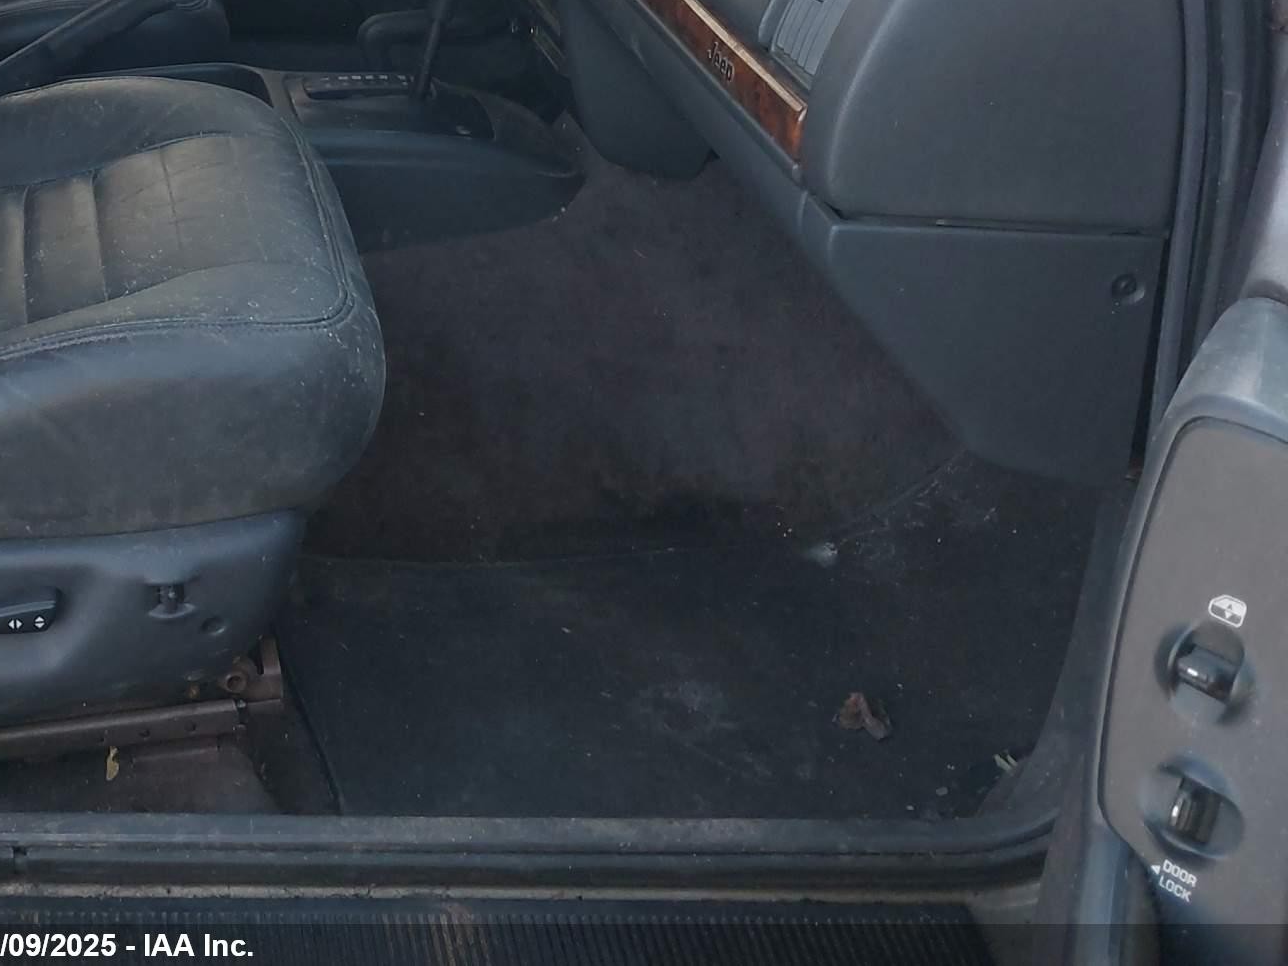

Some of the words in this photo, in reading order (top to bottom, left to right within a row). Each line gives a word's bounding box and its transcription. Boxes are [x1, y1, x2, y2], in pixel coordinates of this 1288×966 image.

[706, 41, 735, 83] Jeep
[1163, 859, 1197, 887] DOOR
[1159, 875, 1192, 902] LOCK
